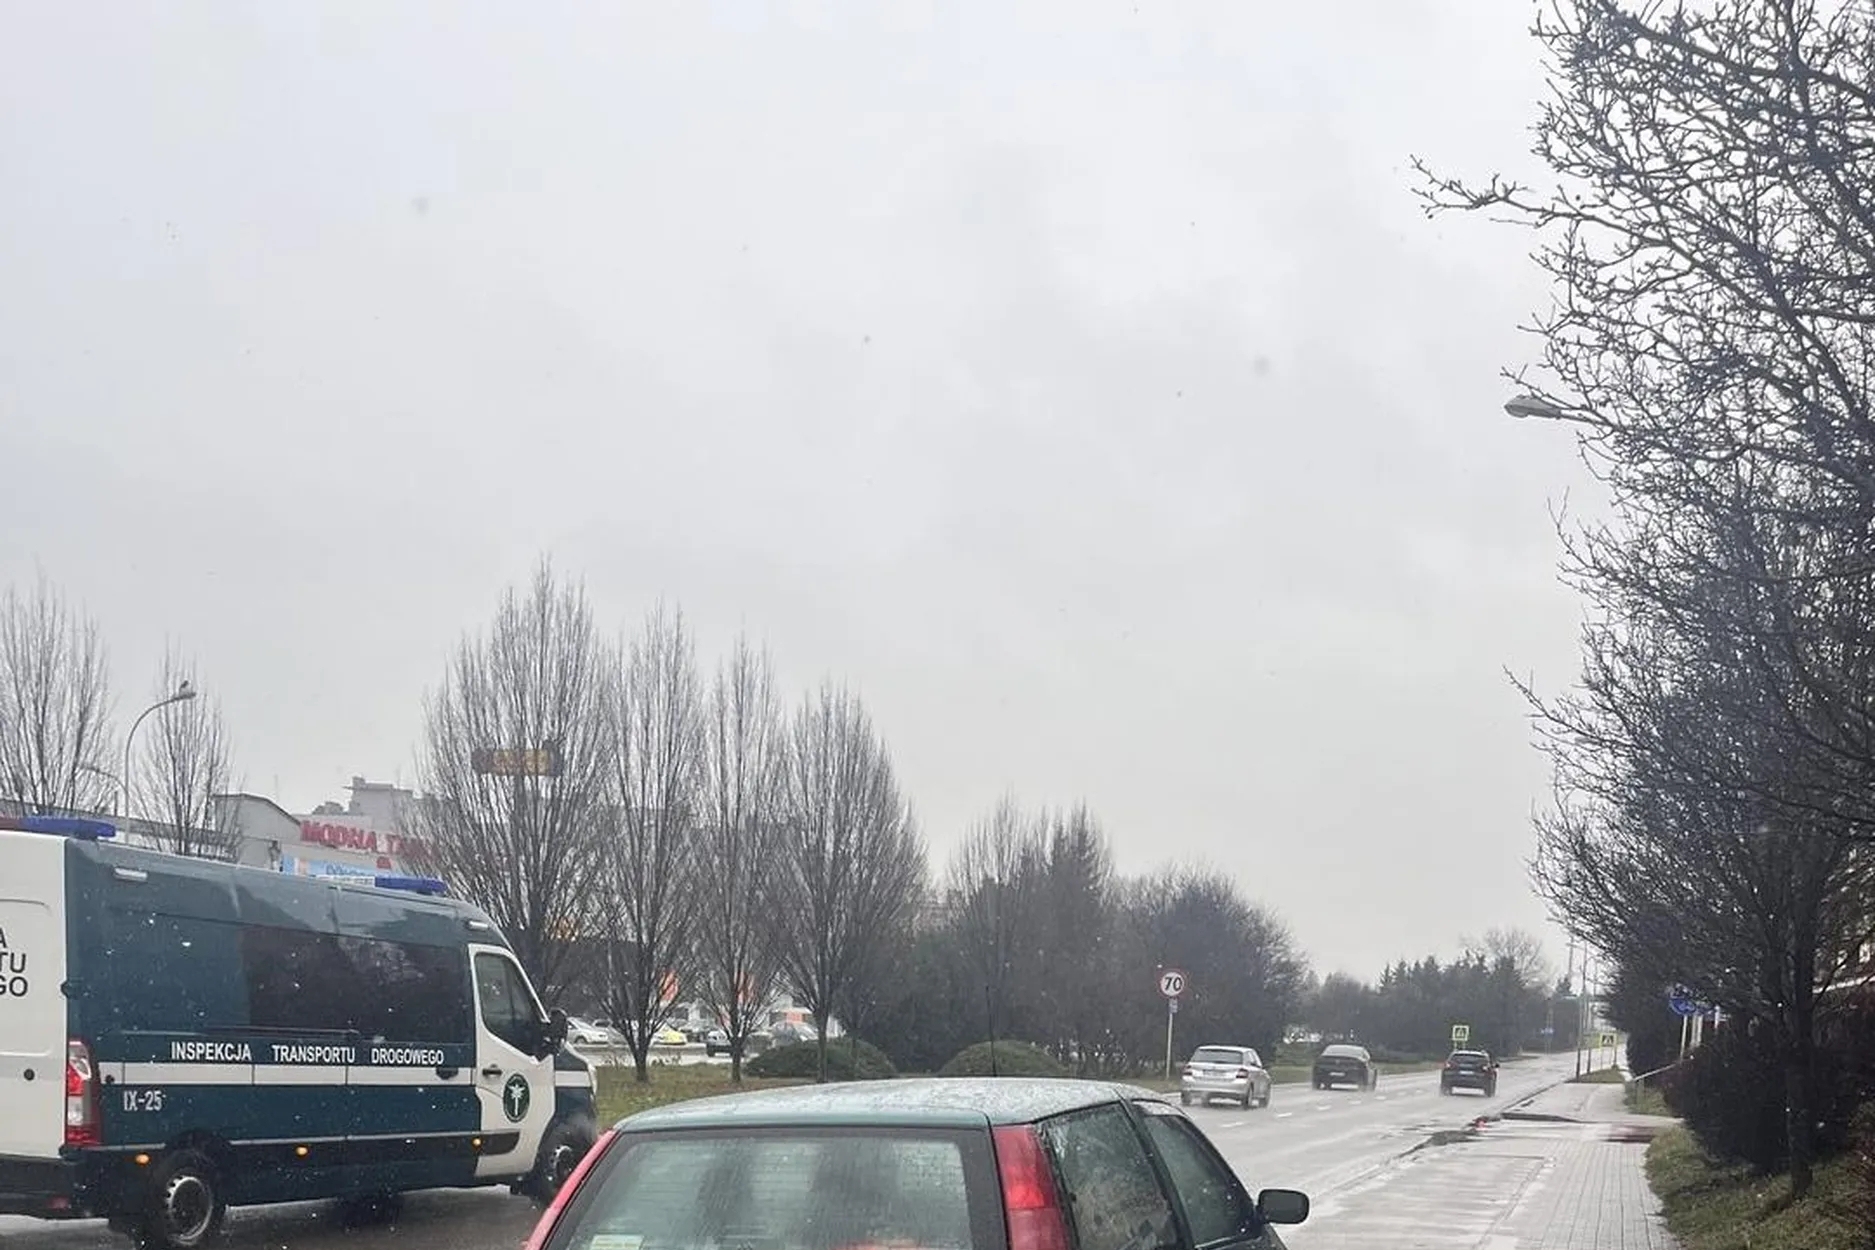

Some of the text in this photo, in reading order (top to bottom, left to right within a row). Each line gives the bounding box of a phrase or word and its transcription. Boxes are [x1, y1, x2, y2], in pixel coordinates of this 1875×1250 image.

[301, 820, 377, 852] MODNA
[1164, 976, 1183, 992] 70
[171, 1041, 444, 1065] INSPEKCJA TRANSPORTU DROGOWEGO
[123, 1090, 162, 1111] IX-25
